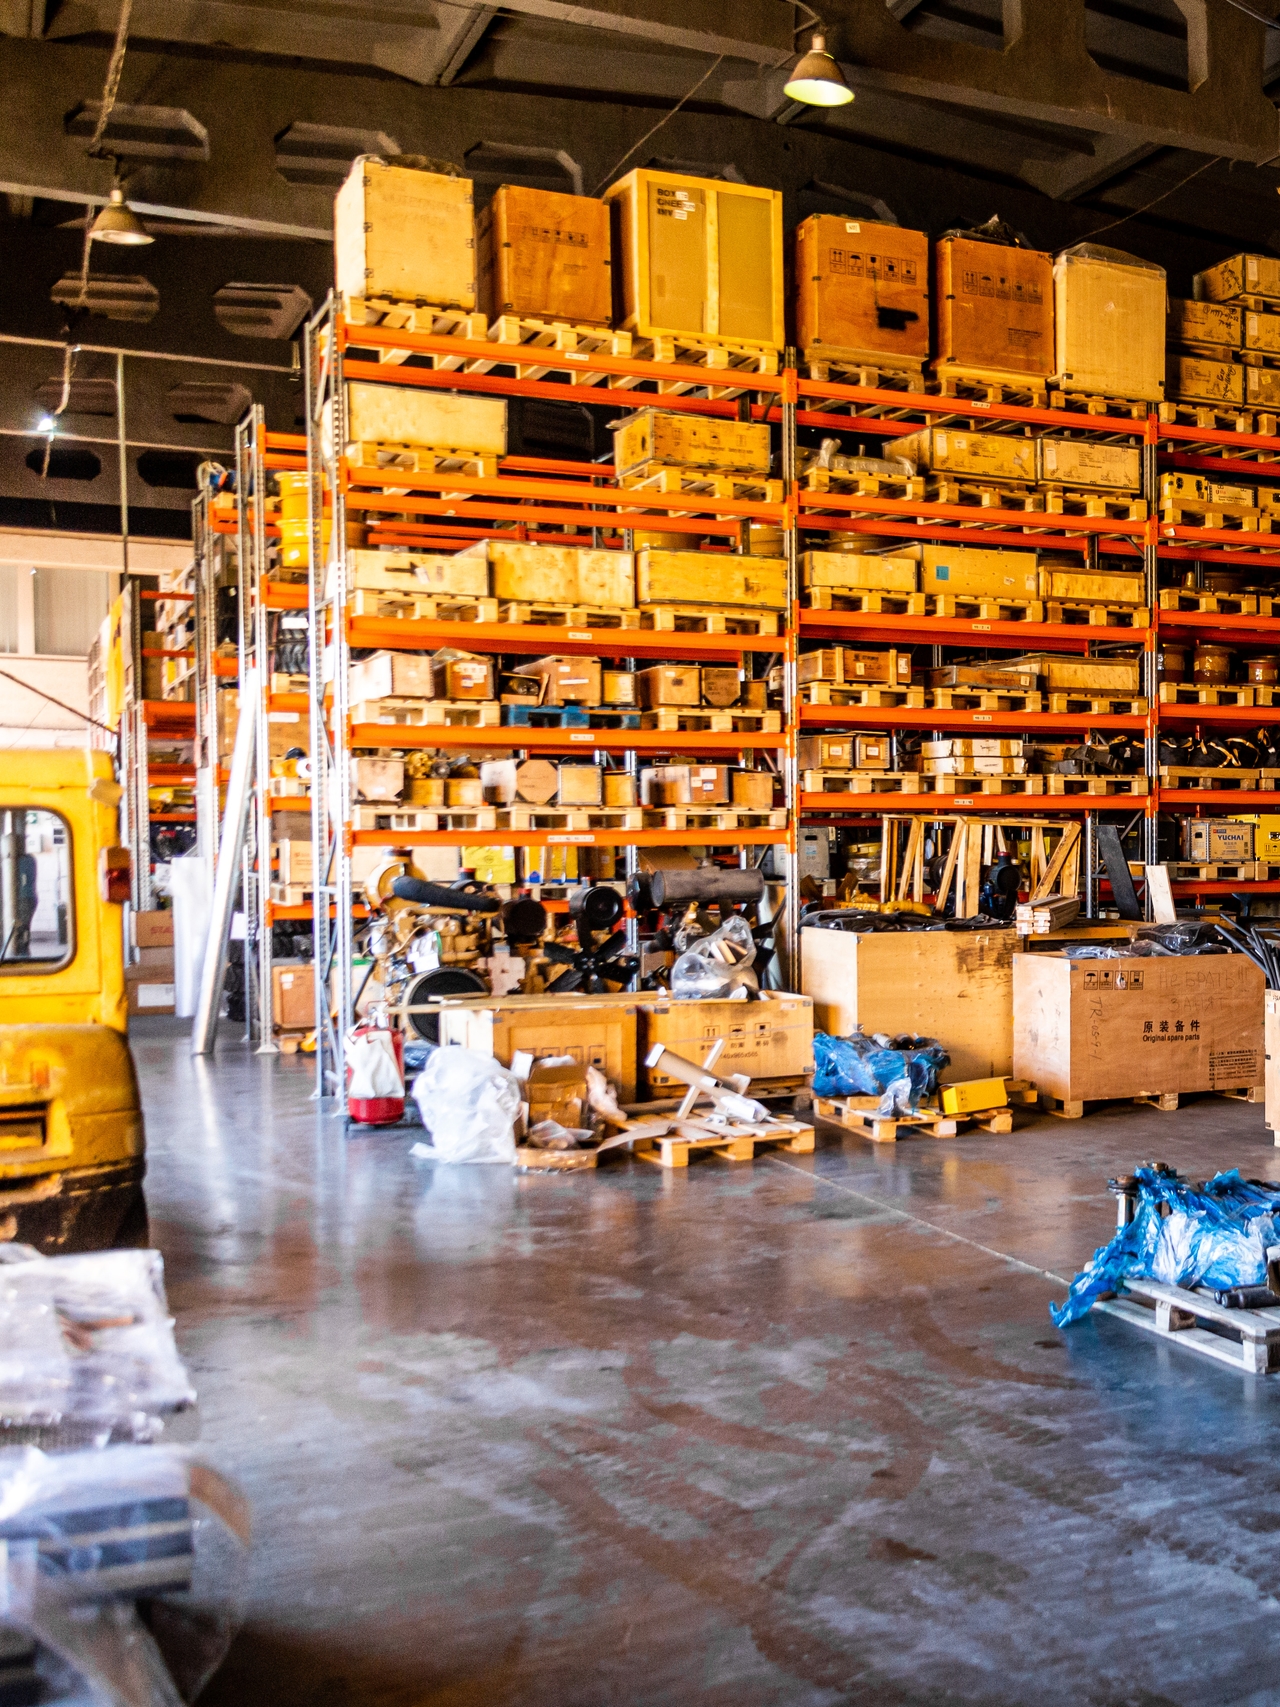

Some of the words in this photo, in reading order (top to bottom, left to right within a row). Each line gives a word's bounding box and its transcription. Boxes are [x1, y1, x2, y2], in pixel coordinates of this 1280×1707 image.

[1143, 1020, 1200, 1033] 原装备件
[1142, 1034, 1167, 1043] Original
[1167, 1034, 1184, 1042] spare
[1185, 1033, 1200, 1042] parts
